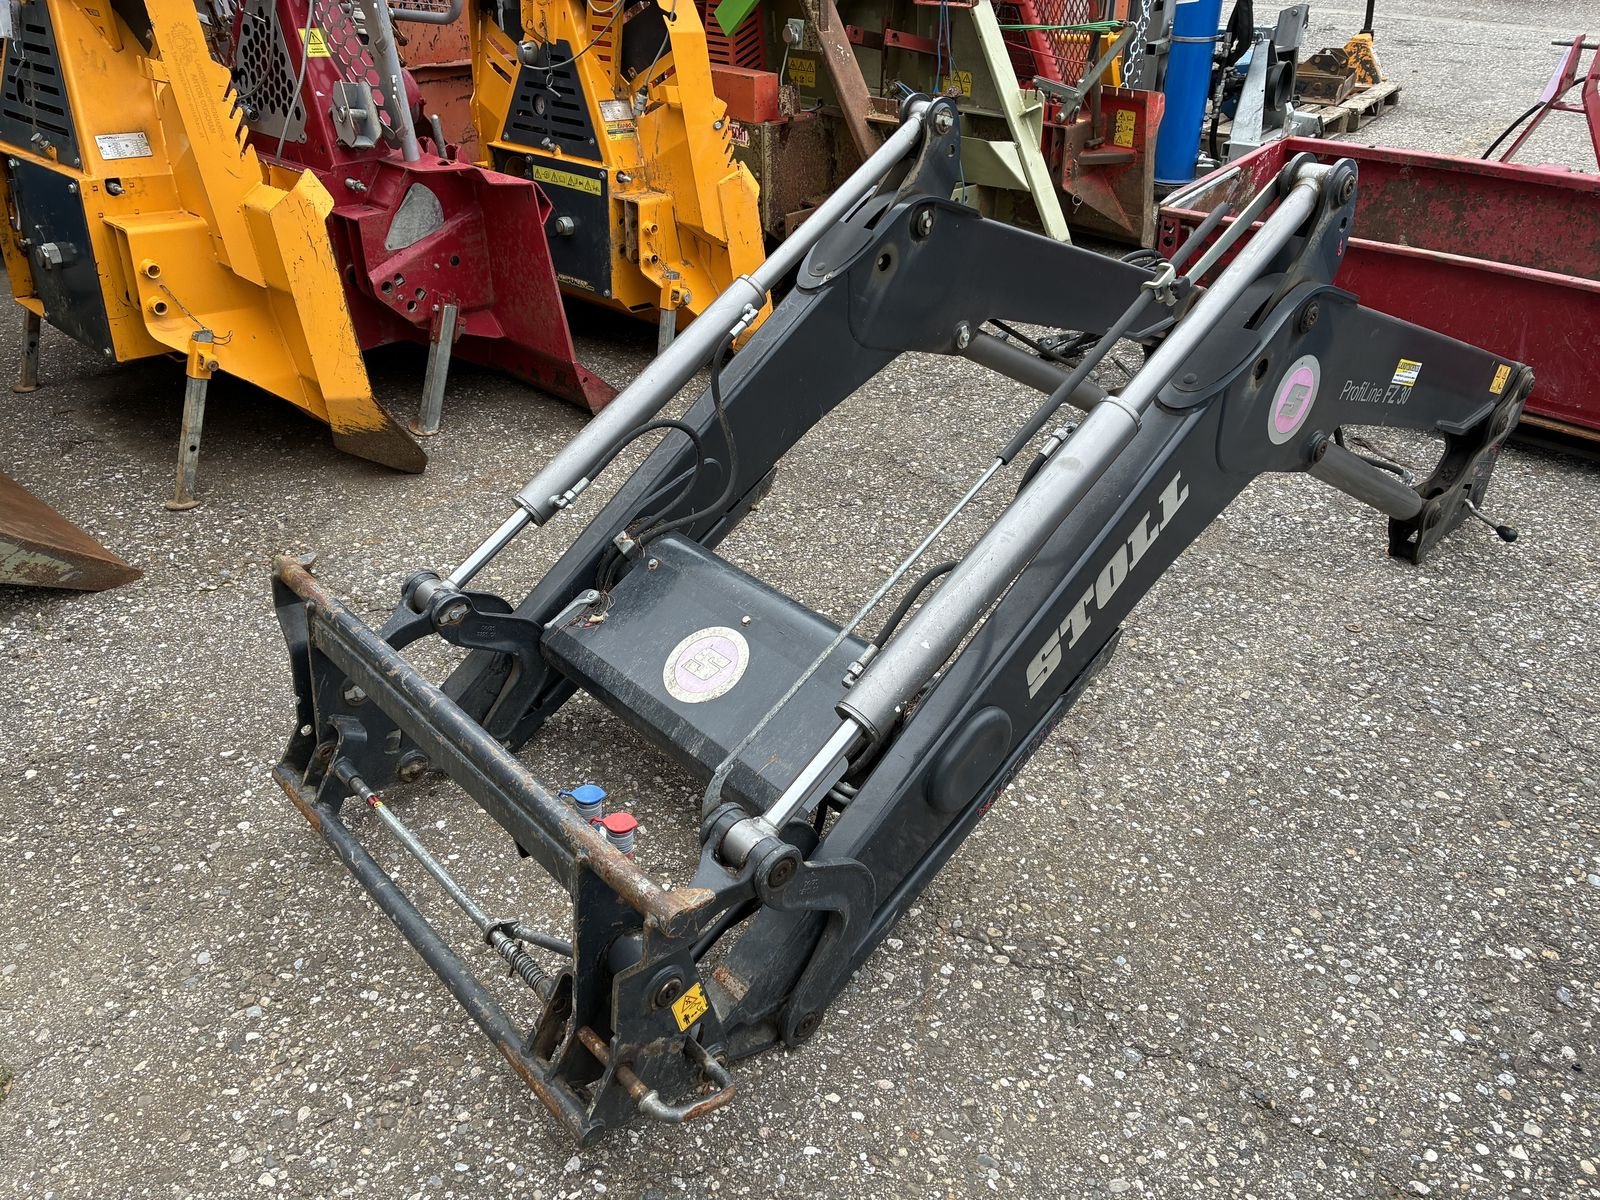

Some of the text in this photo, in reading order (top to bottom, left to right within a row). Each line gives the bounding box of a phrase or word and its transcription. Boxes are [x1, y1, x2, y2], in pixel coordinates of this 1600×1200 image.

[1339, 380, 1412, 405] ProfiLine FZ 30
[1026, 470, 1189, 699] STOLL
